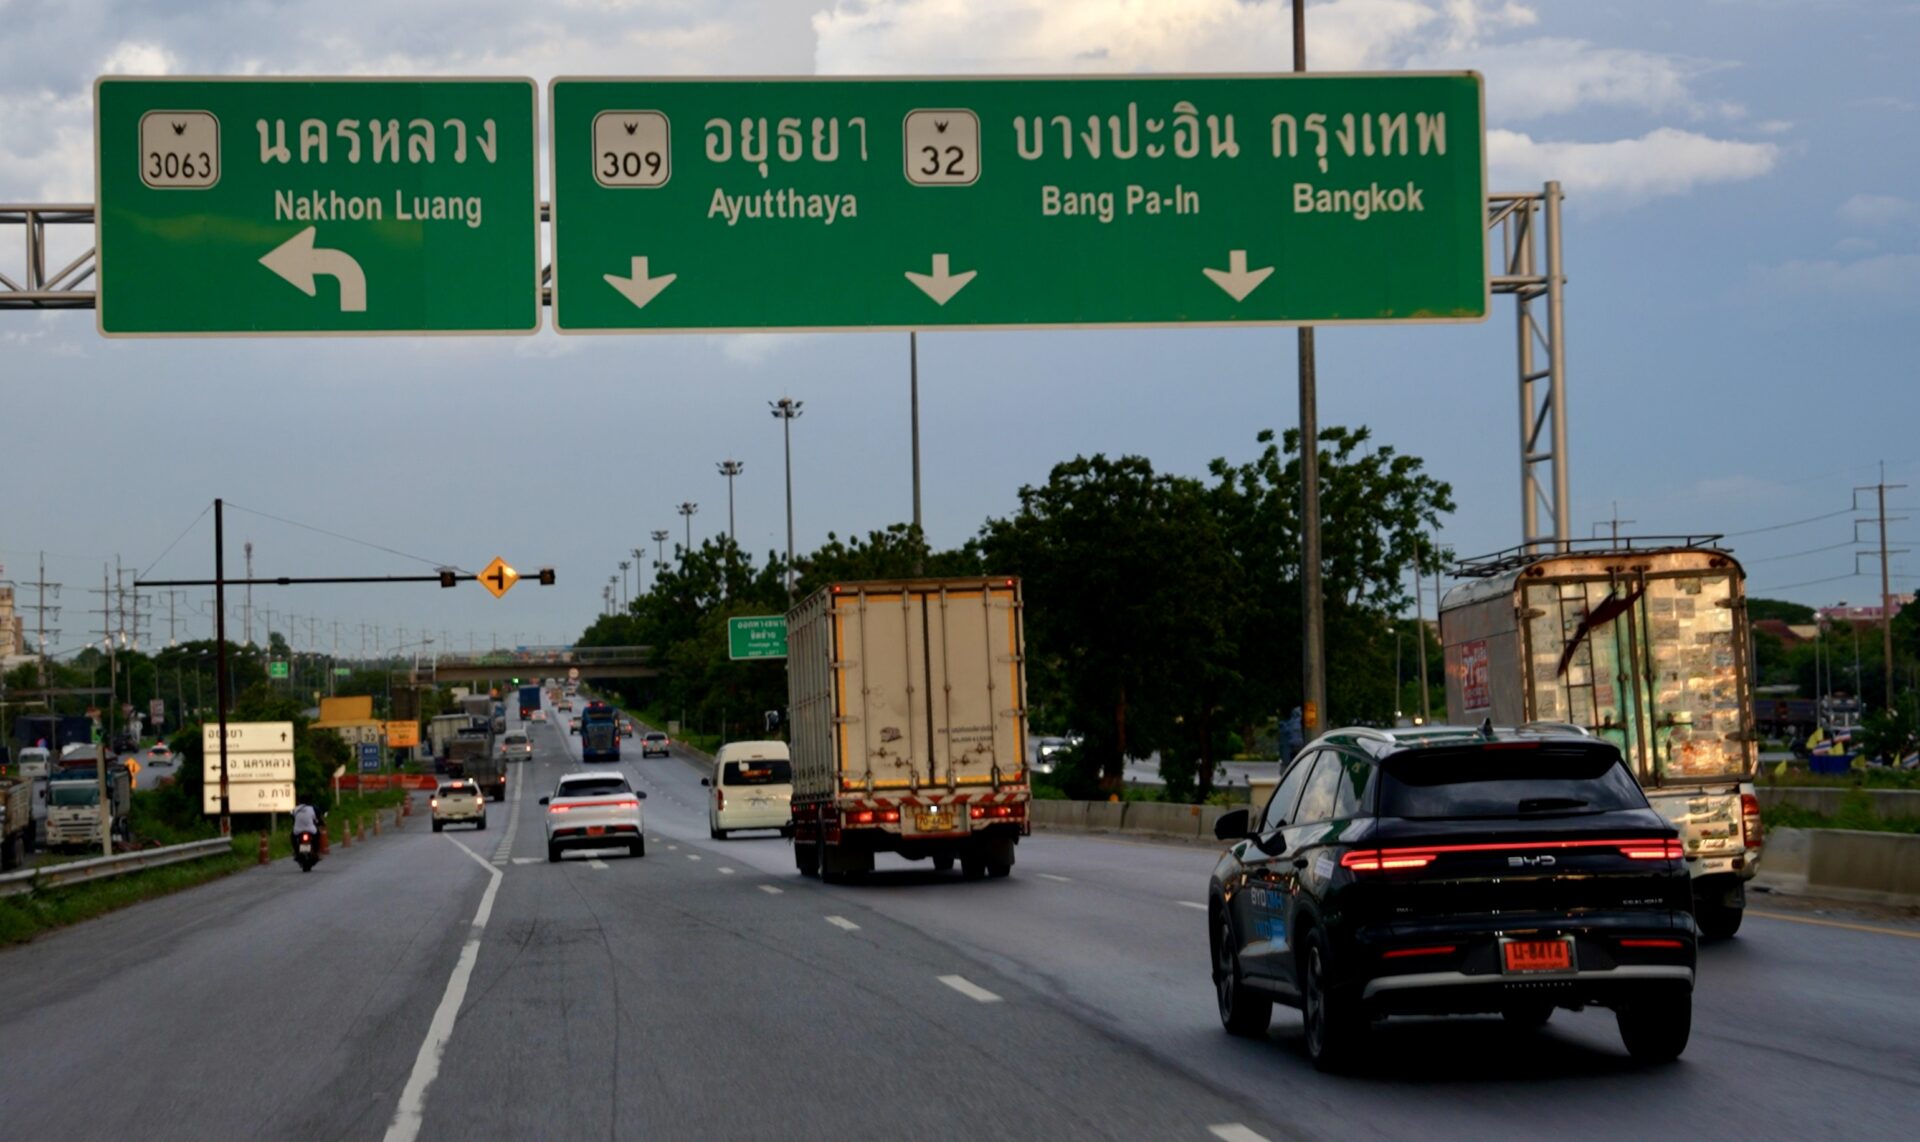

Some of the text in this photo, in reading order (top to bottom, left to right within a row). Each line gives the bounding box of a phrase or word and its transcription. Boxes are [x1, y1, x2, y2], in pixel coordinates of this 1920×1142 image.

[256, 118, 497, 163] นครหลวง
[705, 117, 868, 178] อยุธยา
[1013, 102, 1240, 160] บางปะอิน
[1271, 112, 1446, 173] กรุงเทพ
[149, 153, 211, 179] 3063
[602, 152, 662, 177] 309
[921, 146, 964, 176] 32
[275, 190, 482, 228] Nakhon Luang
[707, 188, 858, 226] Ayutthaya
[1042, 184, 1200, 223] Bang Pa-In
[1293, 182, 1424, 221] Bangkok
[243, 759, 292, 769] นครหลวง
[1507, 854, 1556, 868] BYD
